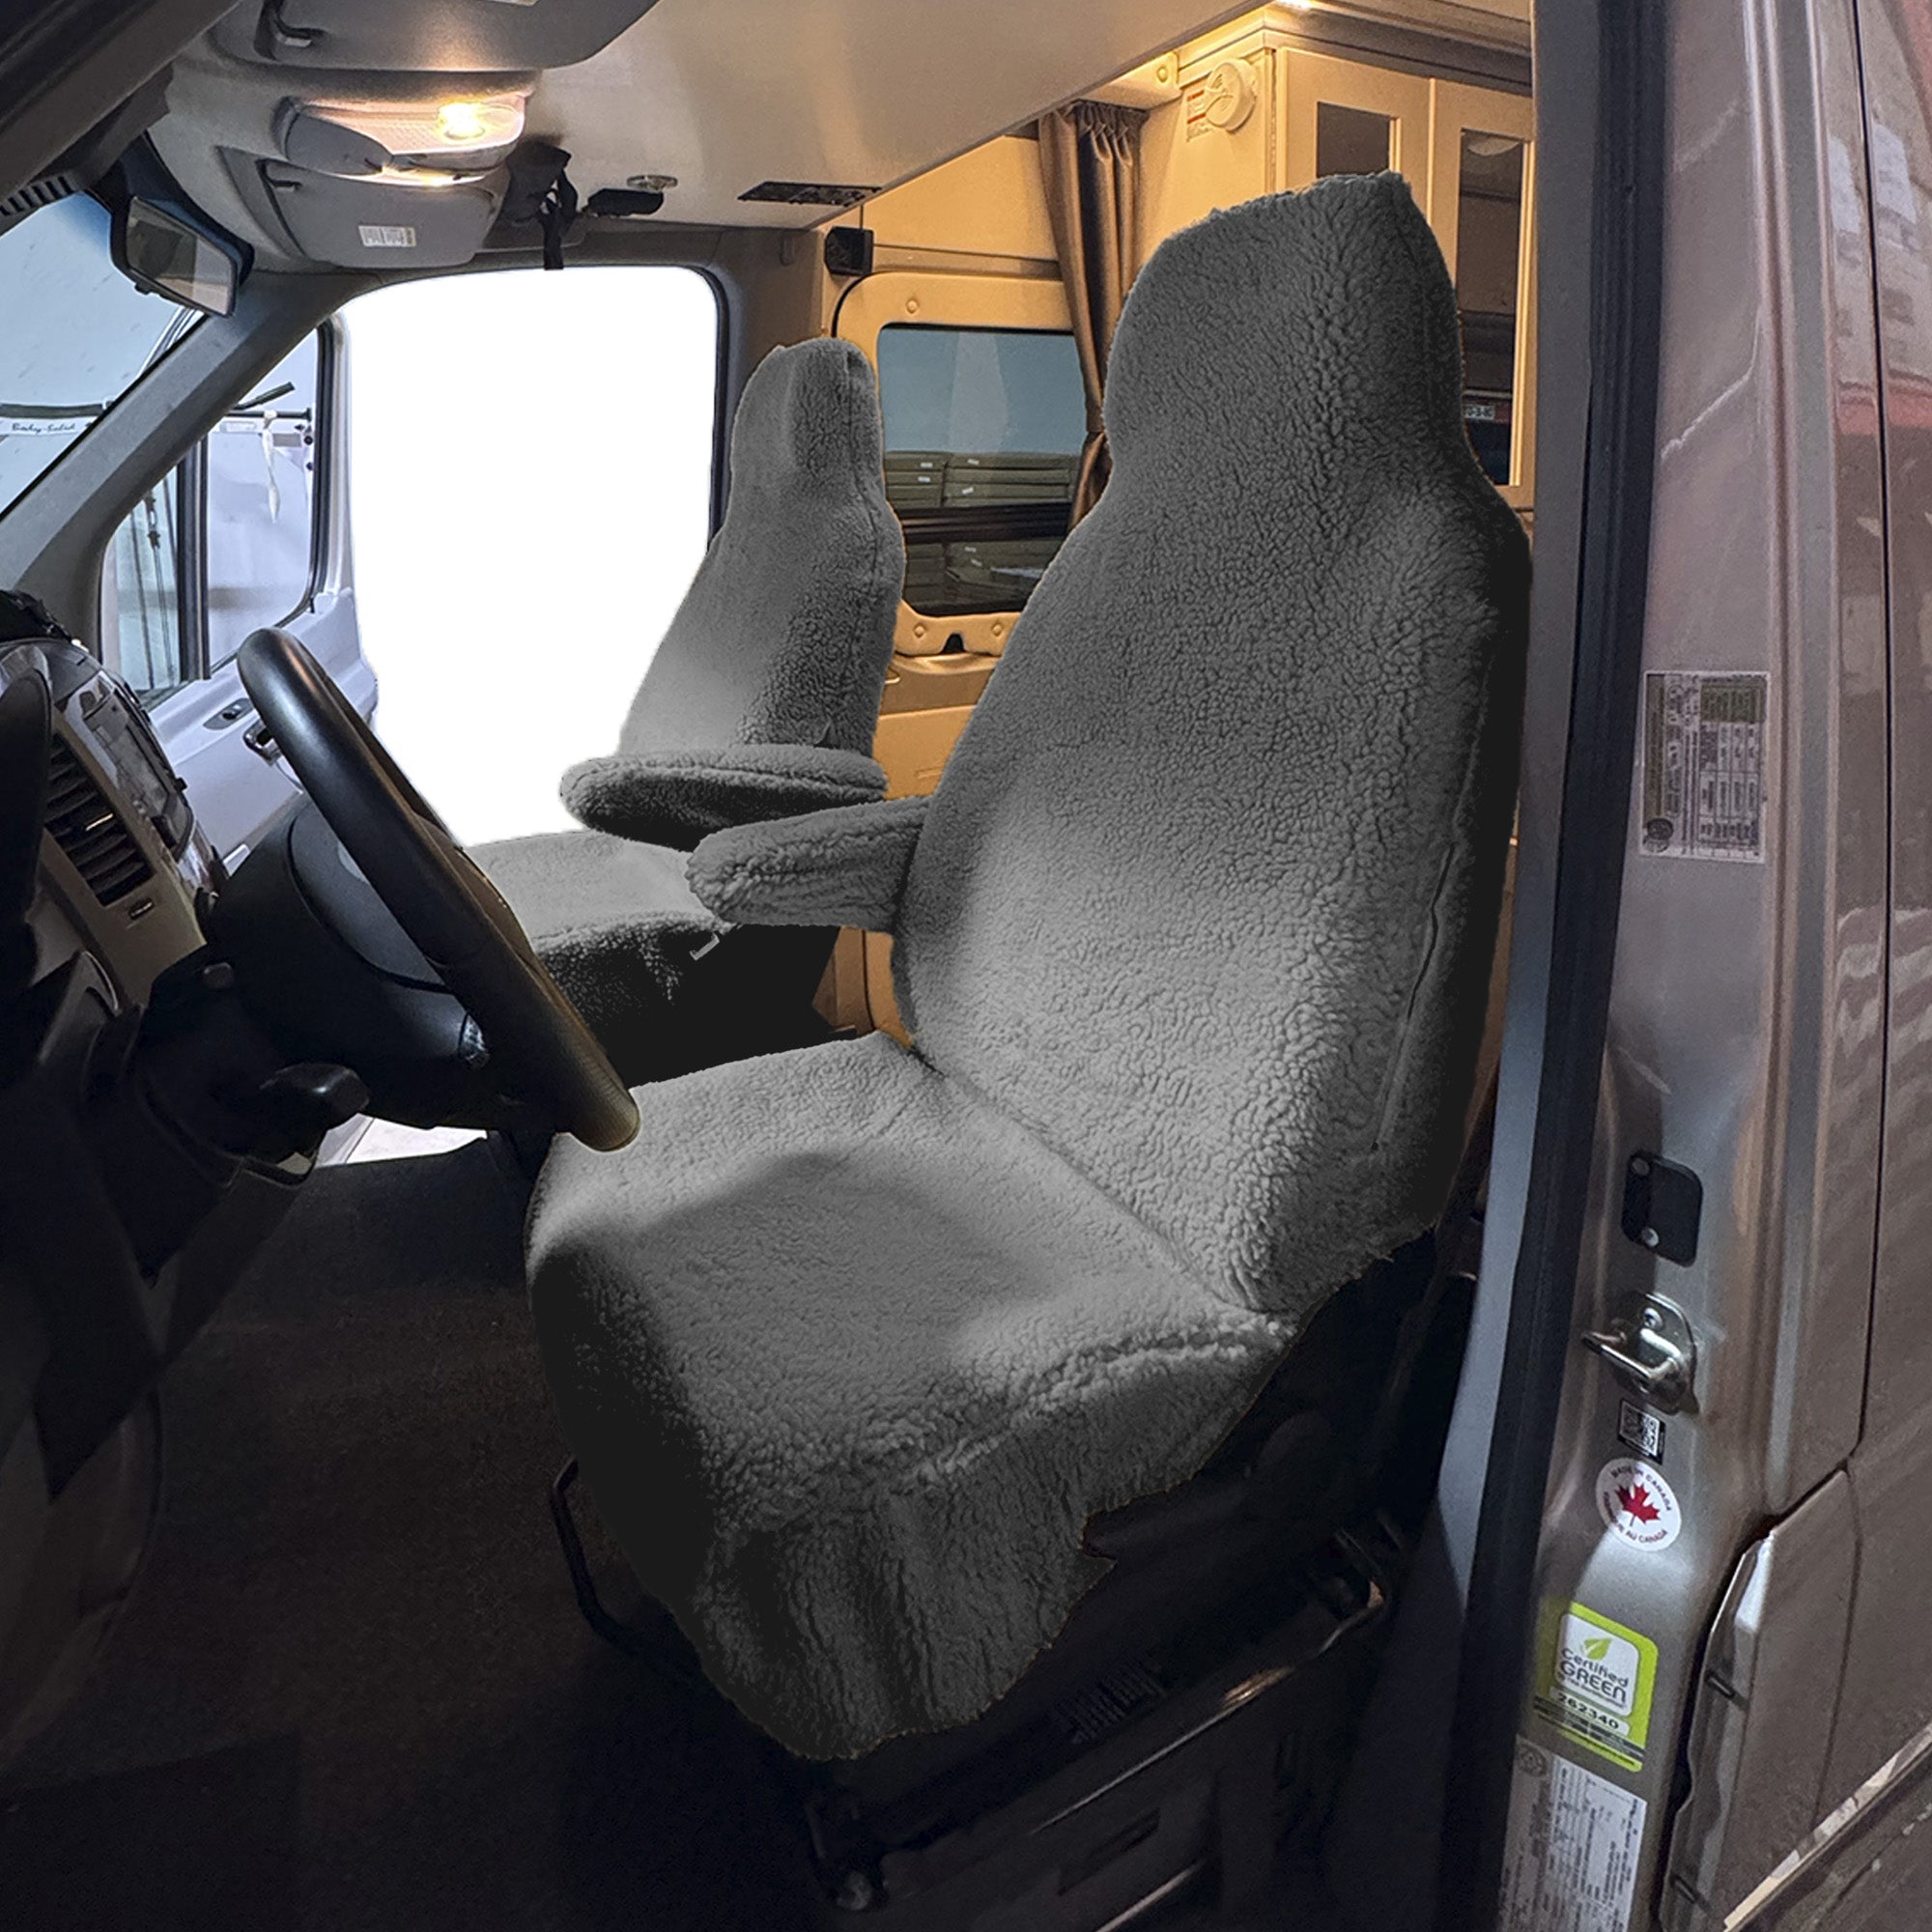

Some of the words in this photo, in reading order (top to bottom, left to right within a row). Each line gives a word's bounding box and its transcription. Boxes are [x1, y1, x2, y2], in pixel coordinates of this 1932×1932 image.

[1645, 1474, 1672, 1511] CANADA
[1638, 1529, 1668, 1544] CANADA
[1560, 1660, 1627, 1703] GREEN
[1561, 1648, 1629, 1688] Certified
[1557, 1692, 1620, 1730] 262340
